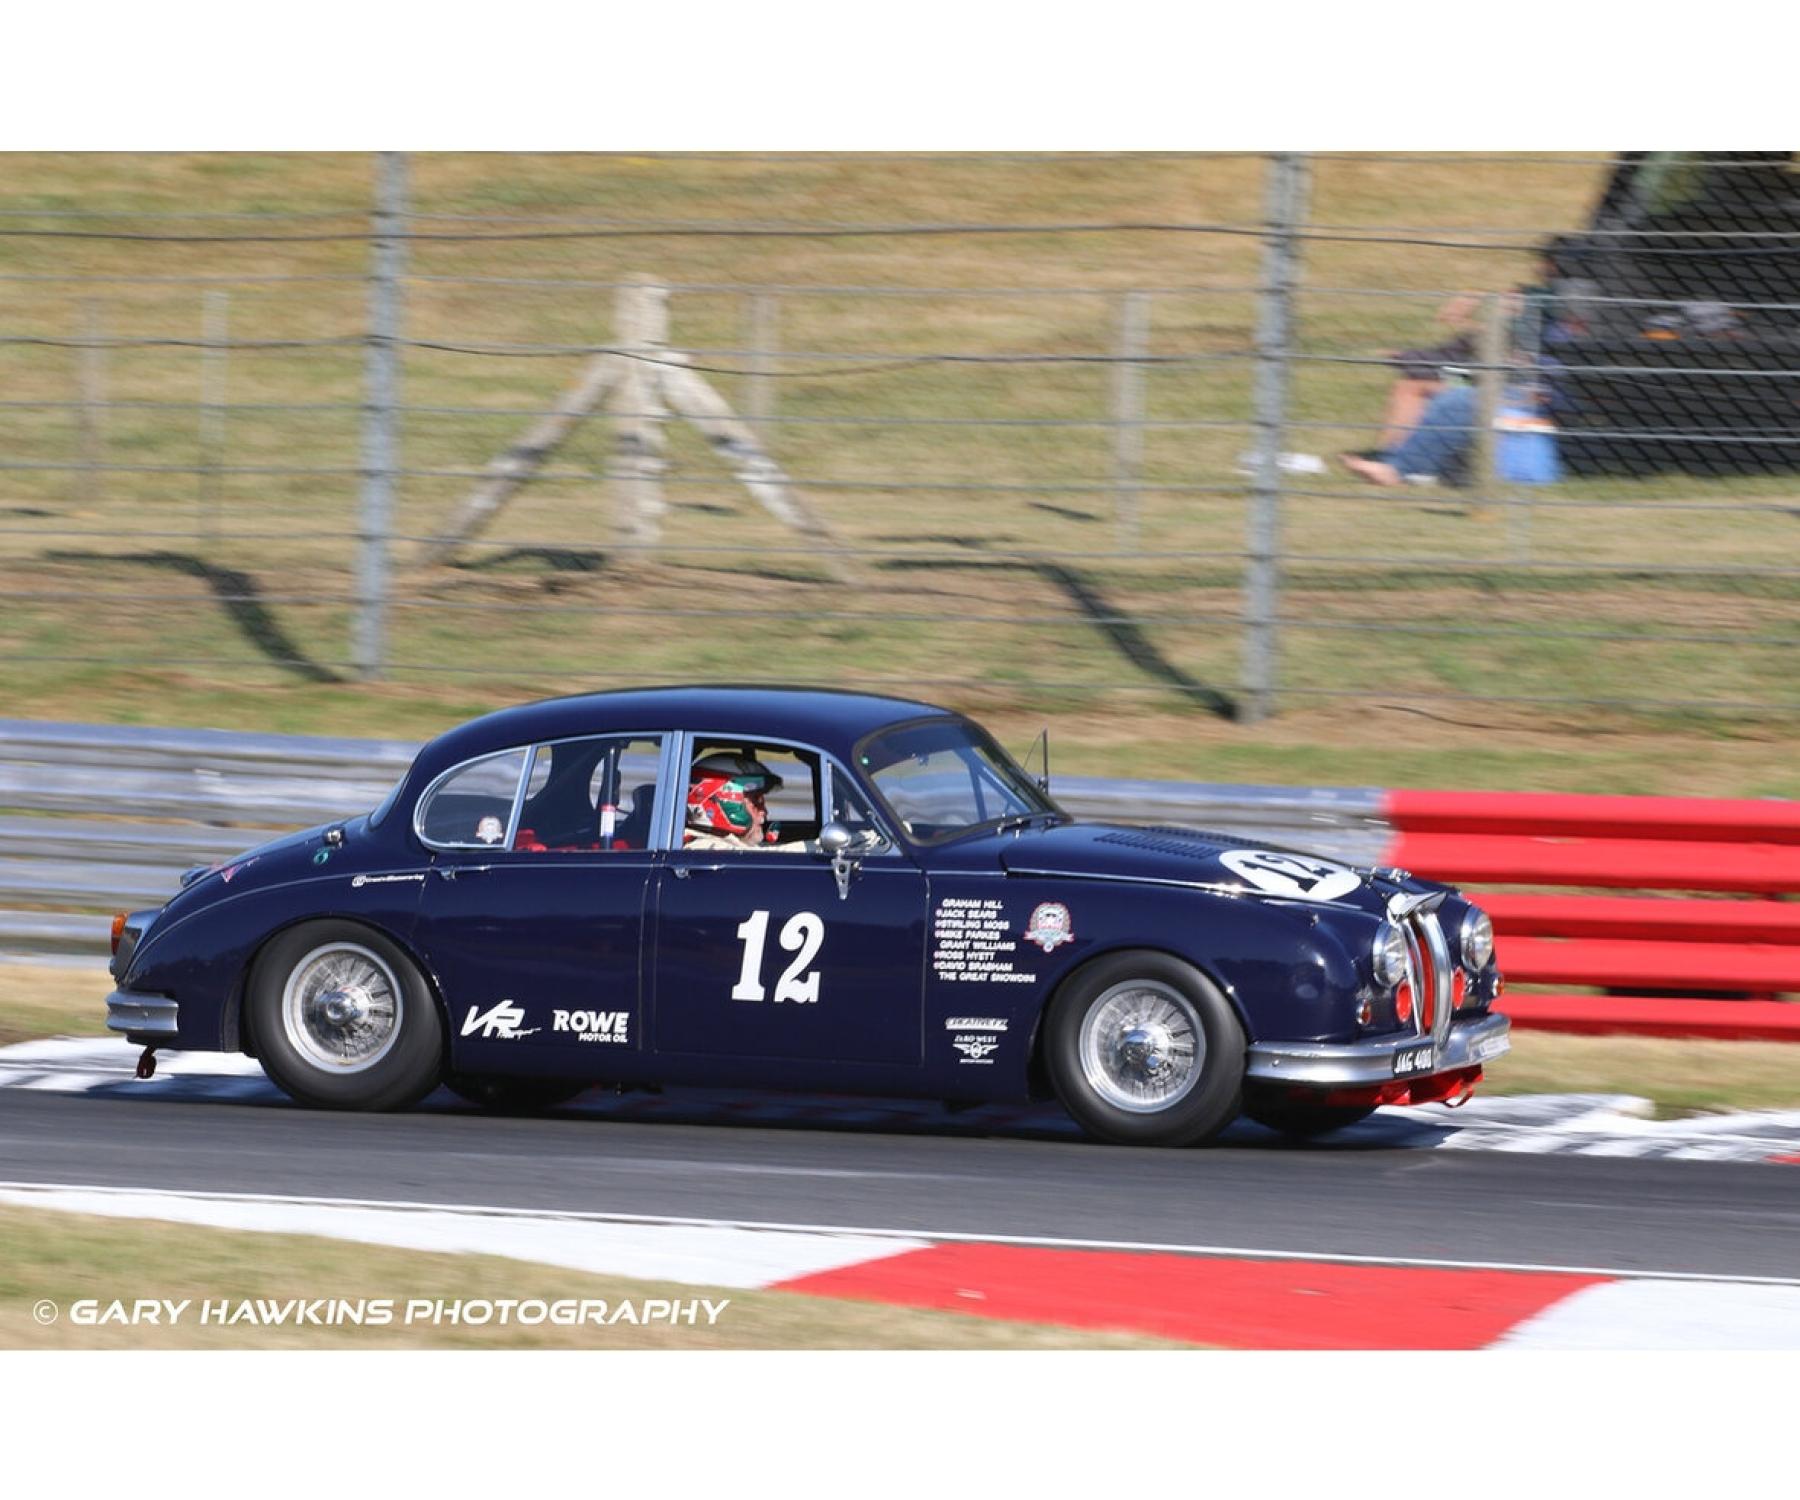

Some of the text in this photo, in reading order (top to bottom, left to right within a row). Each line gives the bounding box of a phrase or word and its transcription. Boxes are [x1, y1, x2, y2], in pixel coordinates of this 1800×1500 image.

[1238, 853, 1337, 893] 12
[942, 899, 1004, 909] GRAHAM HILL
[967, 910, 997, 919] SEARS
[983, 921, 1010, 930] MOSS
[939, 940, 1016, 951] GRANT WILLIAMS
[731, 910, 825, 1003] 12
[938, 972, 957, 980] THE
[959, 972, 988, 981] GREAT
[552, 1010, 629, 1033] ROWE
[578, 1033, 629, 1043] MOTOR OIL
